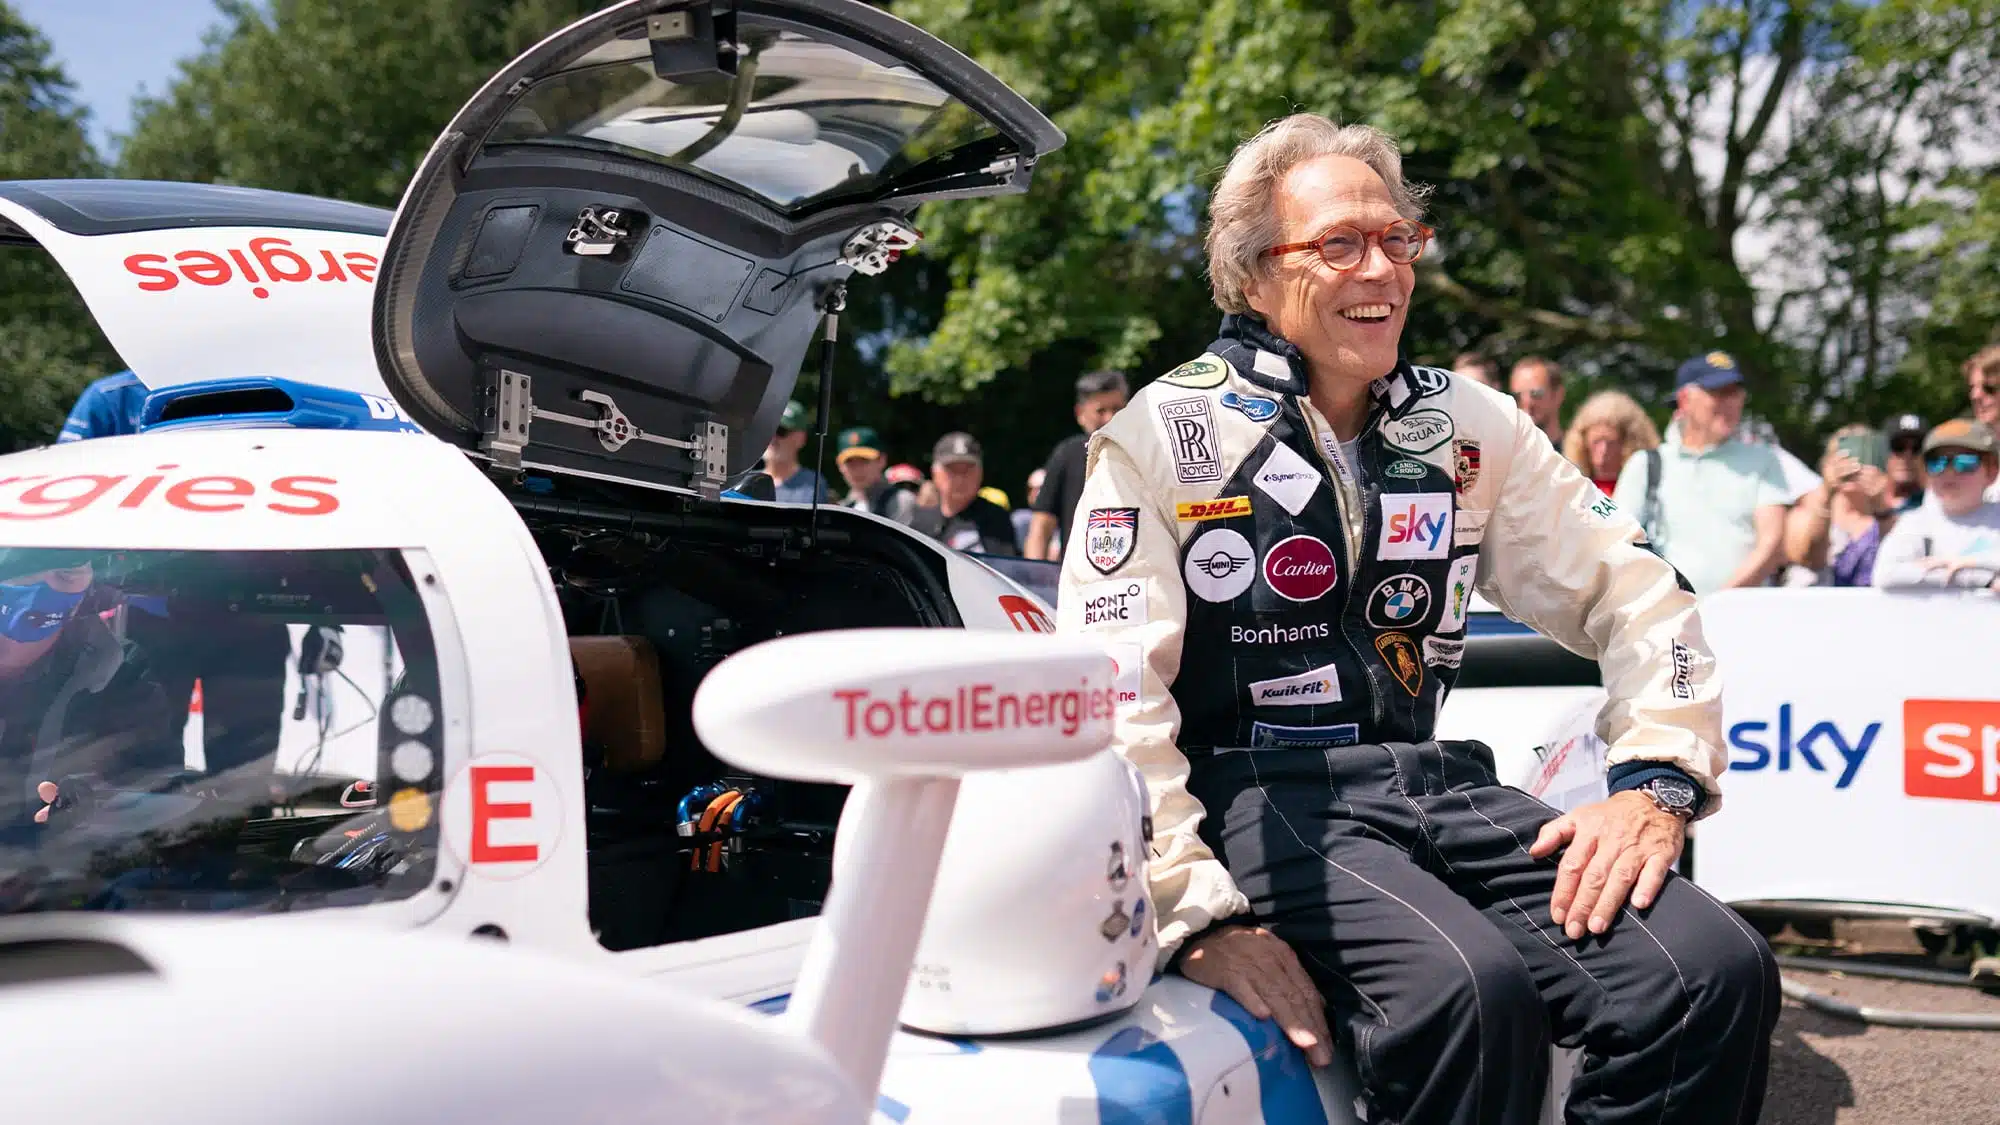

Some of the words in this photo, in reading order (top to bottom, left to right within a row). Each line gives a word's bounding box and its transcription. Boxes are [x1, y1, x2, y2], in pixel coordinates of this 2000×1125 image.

[1166, 402, 1203, 415] ROLLS
[1394, 423, 1446, 445] JAGUAR
[1181, 464, 1216, 477] ROYCE
[1394, 462, 1414, 470] LAND
[1189, 500, 1238, 518] DHL
[1387, 503, 1447, 551] sky
[1095, 555, 1117, 567] BRDC
[1211, 560, 1230, 570] MINI
[1272, 555, 1332, 577] Cartier
[1380, 578, 1427, 601] BMW
[1085, 593, 1128, 613] MONT
[1085, 607, 1128, 625] BLANC
[1231, 622, 1329, 644] Bonhams
[1261, 684, 1300, 699] Kwik
[1301, 680, 1323, 695] Fit
[832, 676, 1118, 740] TotalEnergies
[1728, 703, 1883, 789] sky
[470, 766, 538, 864] E
